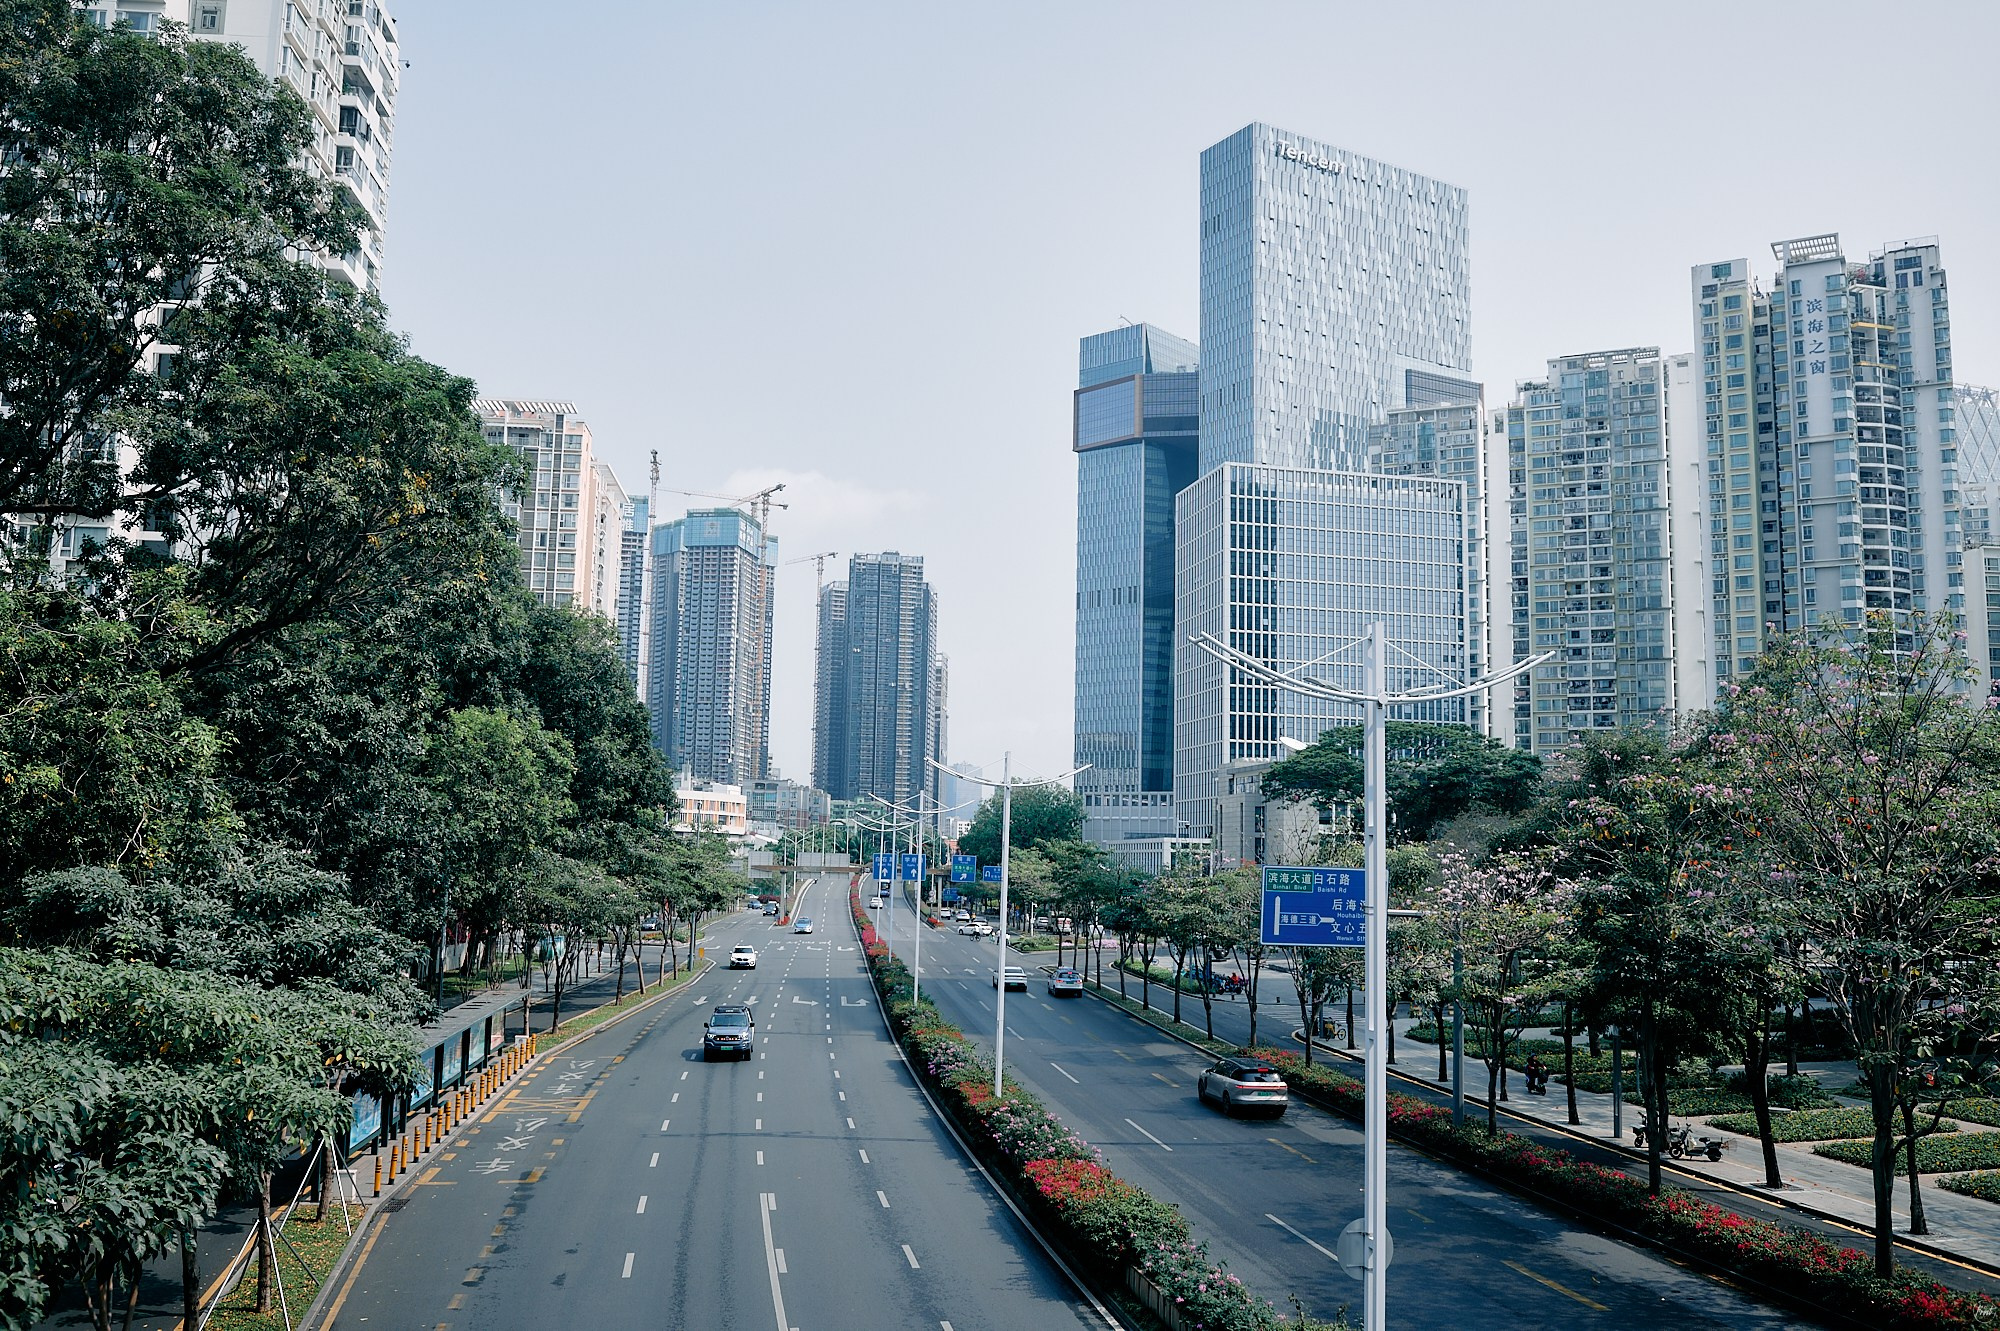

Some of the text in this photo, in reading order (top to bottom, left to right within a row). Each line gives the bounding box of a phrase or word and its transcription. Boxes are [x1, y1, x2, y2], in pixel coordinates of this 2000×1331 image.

[1806, 298, 1826, 375] 滨海之窗
[1268, 872, 1350, 886] 滨海大道 白石路
[1280, 914, 1317, 925] 海德三道
